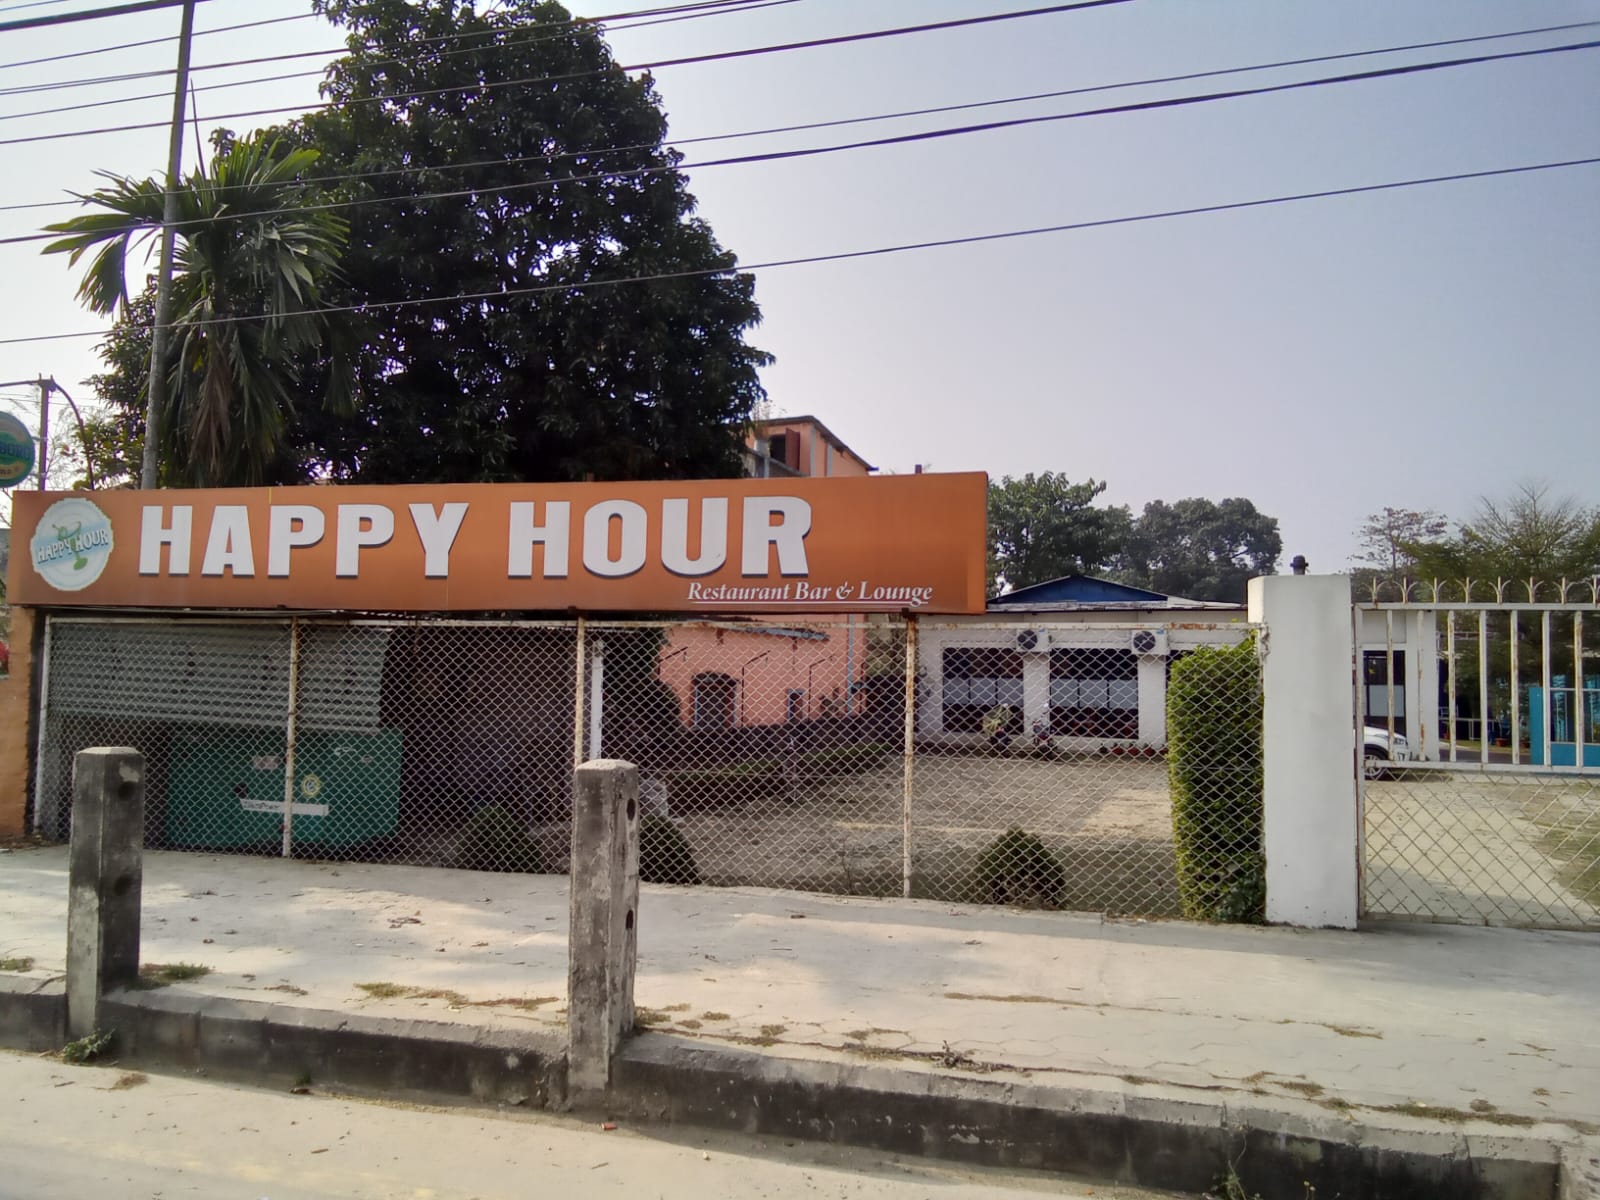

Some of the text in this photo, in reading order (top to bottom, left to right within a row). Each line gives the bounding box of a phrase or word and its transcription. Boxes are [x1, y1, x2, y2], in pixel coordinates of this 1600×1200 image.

[38, 528, 110, 563] HAPPY HOUR
[138, 496, 812, 577] HAPPY HOUR
[687, 581, 934, 608] Restaurant Bar & Lounge
